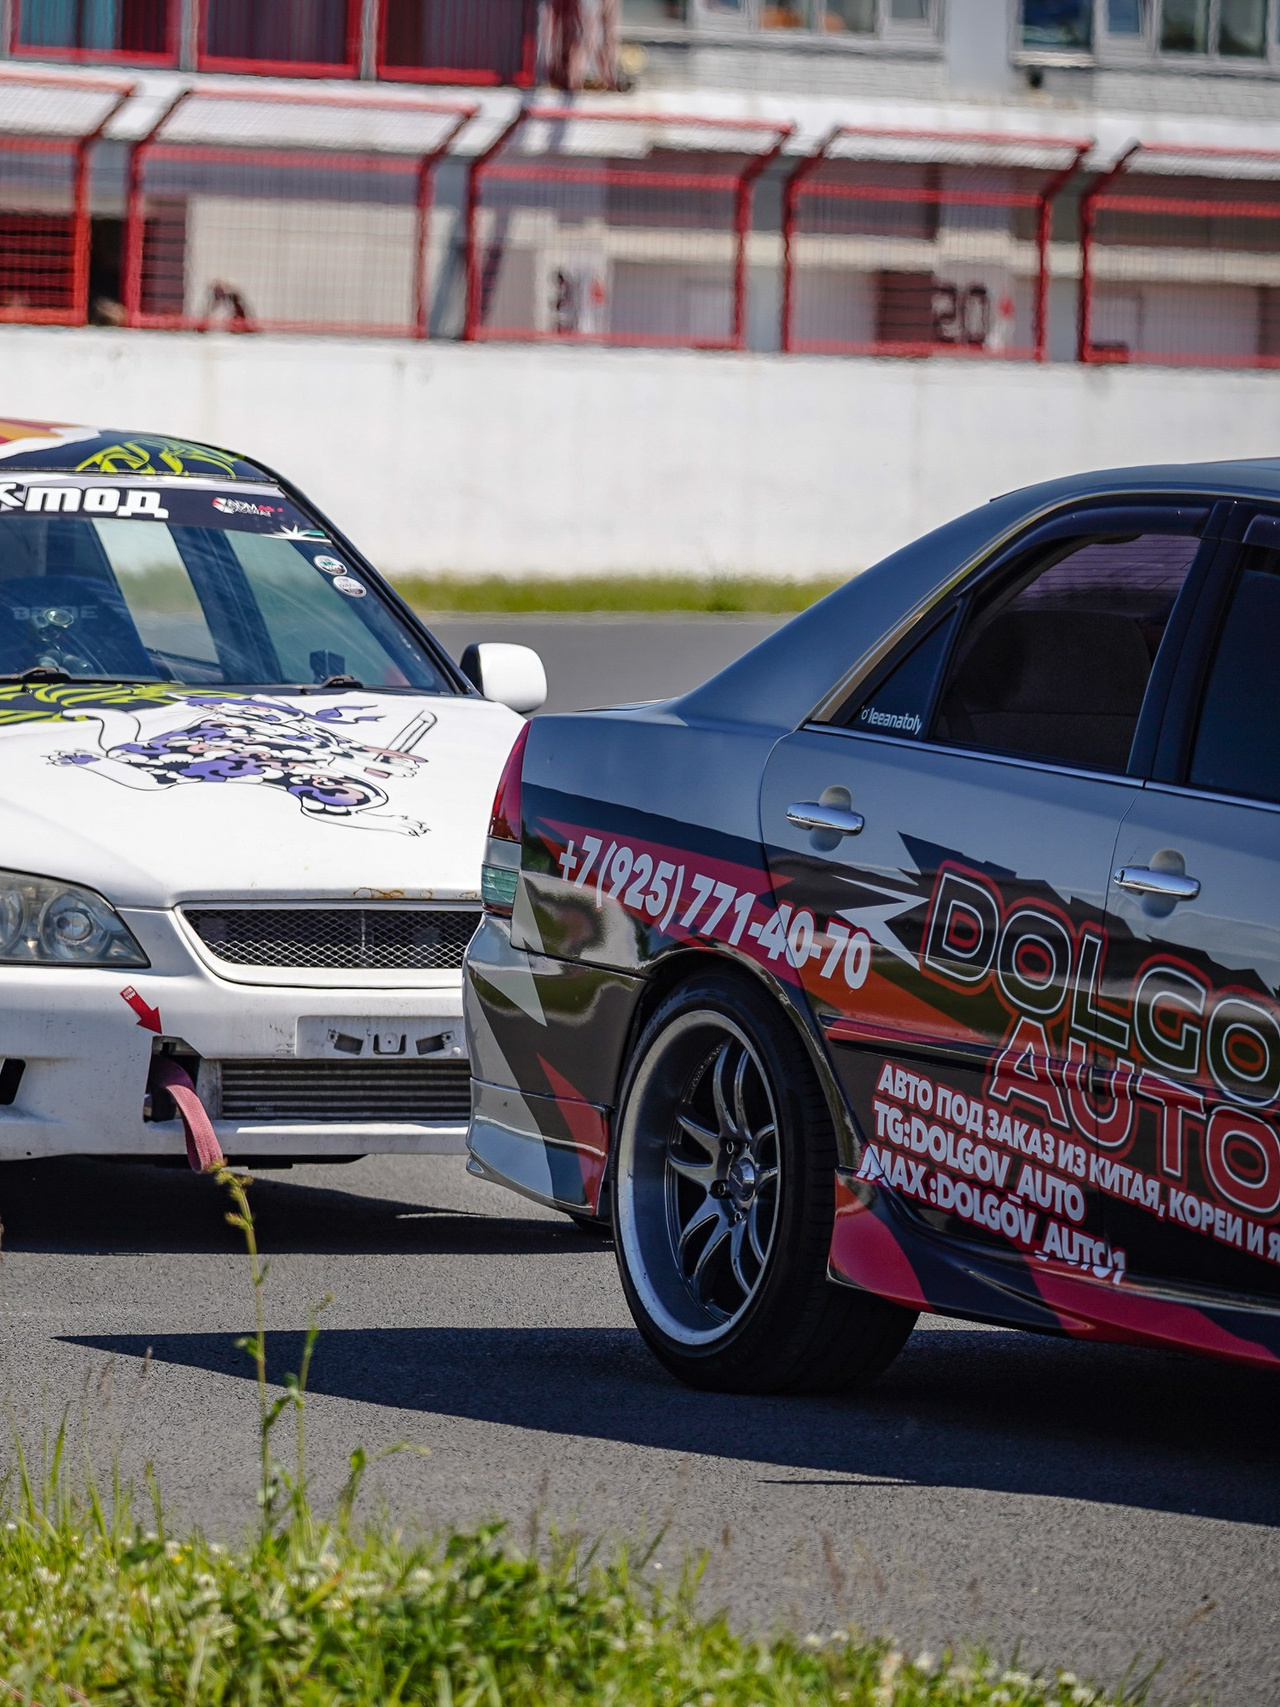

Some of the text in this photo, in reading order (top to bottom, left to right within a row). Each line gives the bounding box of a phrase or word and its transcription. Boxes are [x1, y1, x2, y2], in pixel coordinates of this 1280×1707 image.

[12, 605, 99, 621] BRDE
[868, 707, 922, 735] leeanatoly
[877, 1064, 933, 1111] АВТО
[936, 1086, 984, 1139] ПОД
[986, 1108, 1055, 1164] ЗАКАЗ
[1057, 1139, 1086, 1178] ИЗ
[1089, 1153, 1165, 1217] КИТАЯ,
[1169, 1187, 1242, 1247] КОРЕИ
[1246, 1221, 1264, 1256] И
[988, 1015, 1280, 1213] AUTO
